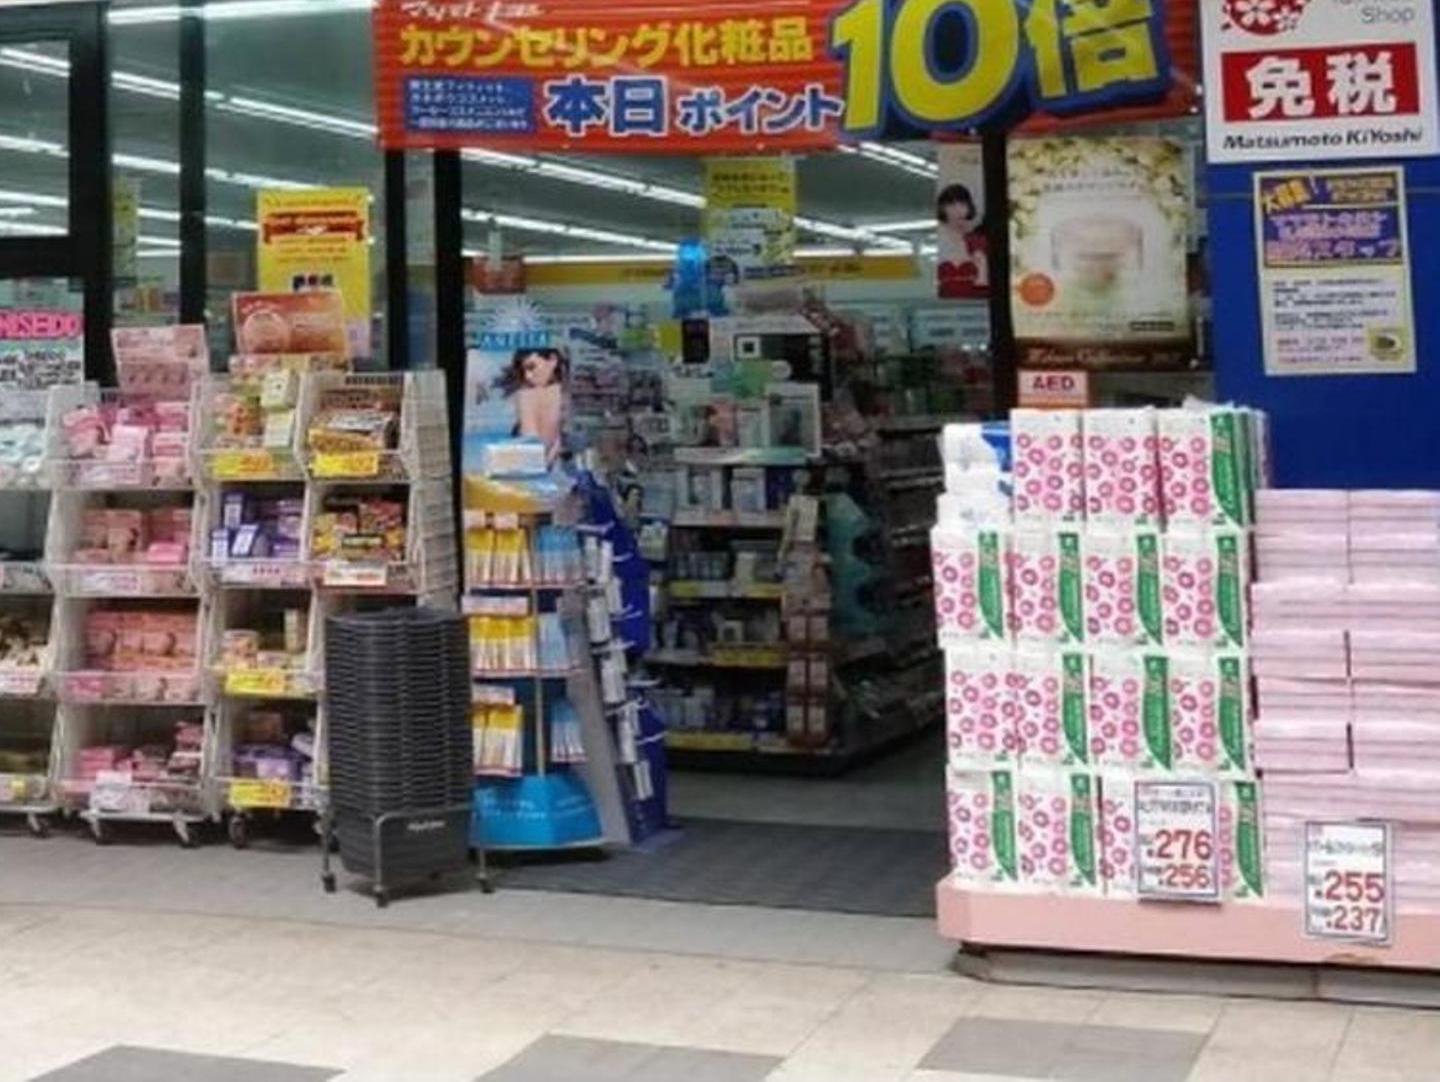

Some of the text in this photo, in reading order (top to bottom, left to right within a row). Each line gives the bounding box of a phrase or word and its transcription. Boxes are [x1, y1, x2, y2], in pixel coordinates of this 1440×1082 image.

[1361, 6, 1416, 25] Shop
[400, 18, 812, 67] カウンセリング化粧品
[1245, 51, 1397, 119] 免税
[1223, 126, 1423, 150] Matsumoto KiYoshi
[1032, 375, 1075, 391] AED
